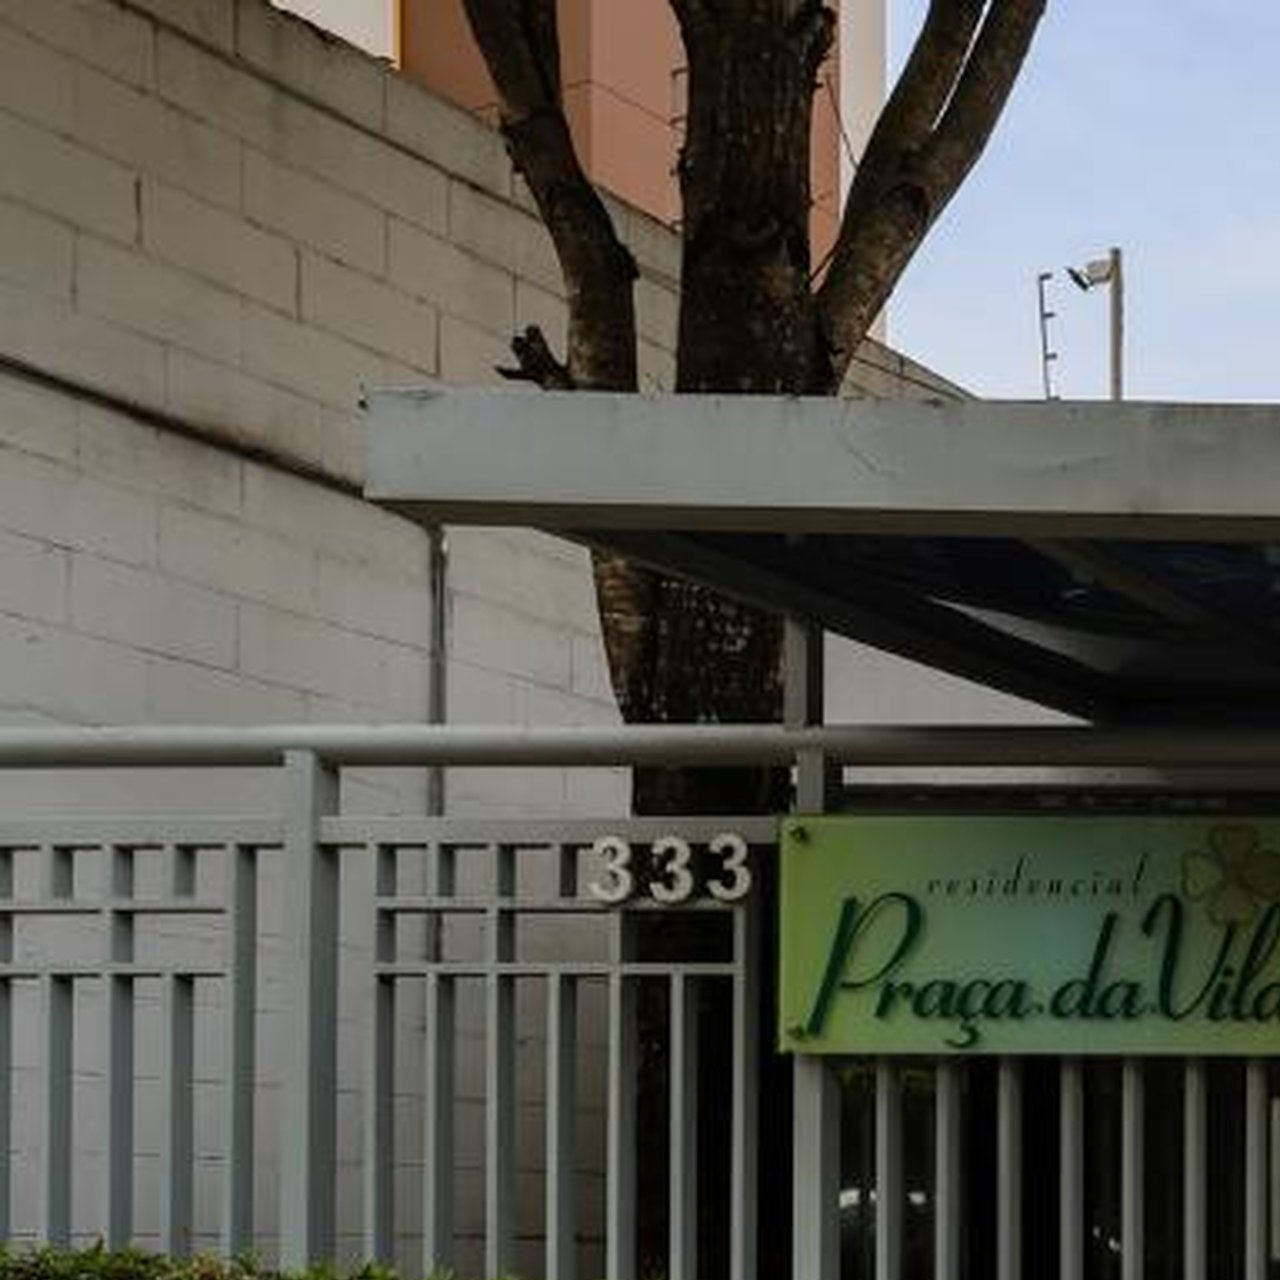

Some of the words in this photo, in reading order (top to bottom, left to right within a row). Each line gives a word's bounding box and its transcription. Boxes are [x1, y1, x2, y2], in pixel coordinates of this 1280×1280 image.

[588, 832, 751, 902] 333
[927, 852, 1149, 896] residencial
[806, 892, 1042, 1048] Praça
[1050, 911, 1150, 1019] da
